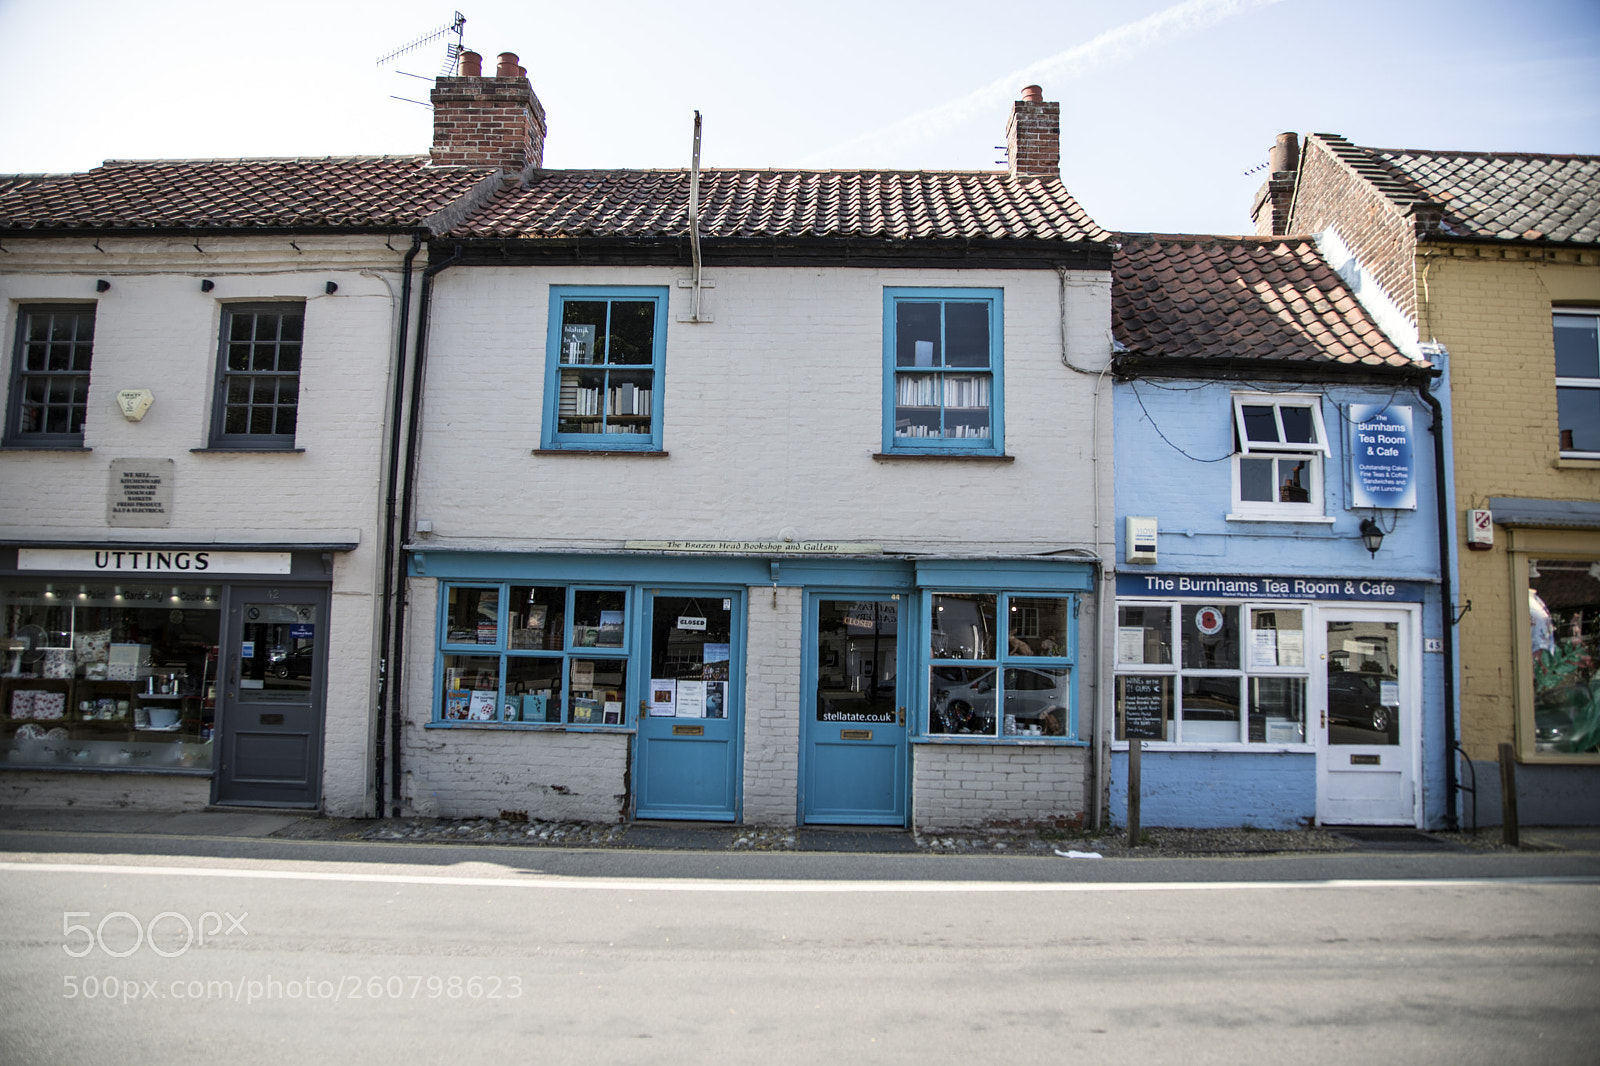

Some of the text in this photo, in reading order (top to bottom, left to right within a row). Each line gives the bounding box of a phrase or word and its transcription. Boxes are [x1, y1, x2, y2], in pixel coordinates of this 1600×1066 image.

[1358, 422, 1406, 432] Burnhams
[1358, 433, 1406, 444] Tea Room
[1367, 446, 1399, 456] & Cafe
[1359, 464, 1391, 472] Outstanding
[743, 542, 782, 551] Bookshop
[785, 542, 800, 550] and
[803, 543, 839, 552] Gallery
[94, 551, 210, 570] UTTINGS
[1144, 576, 1395, 596] The Burnhams Tea Room & Cafe
[844, 616, 873, 628] CLOSED
[1428, 641, 1440, 650] 45
[823, 711, 892, 722] stellatate.co.uk
